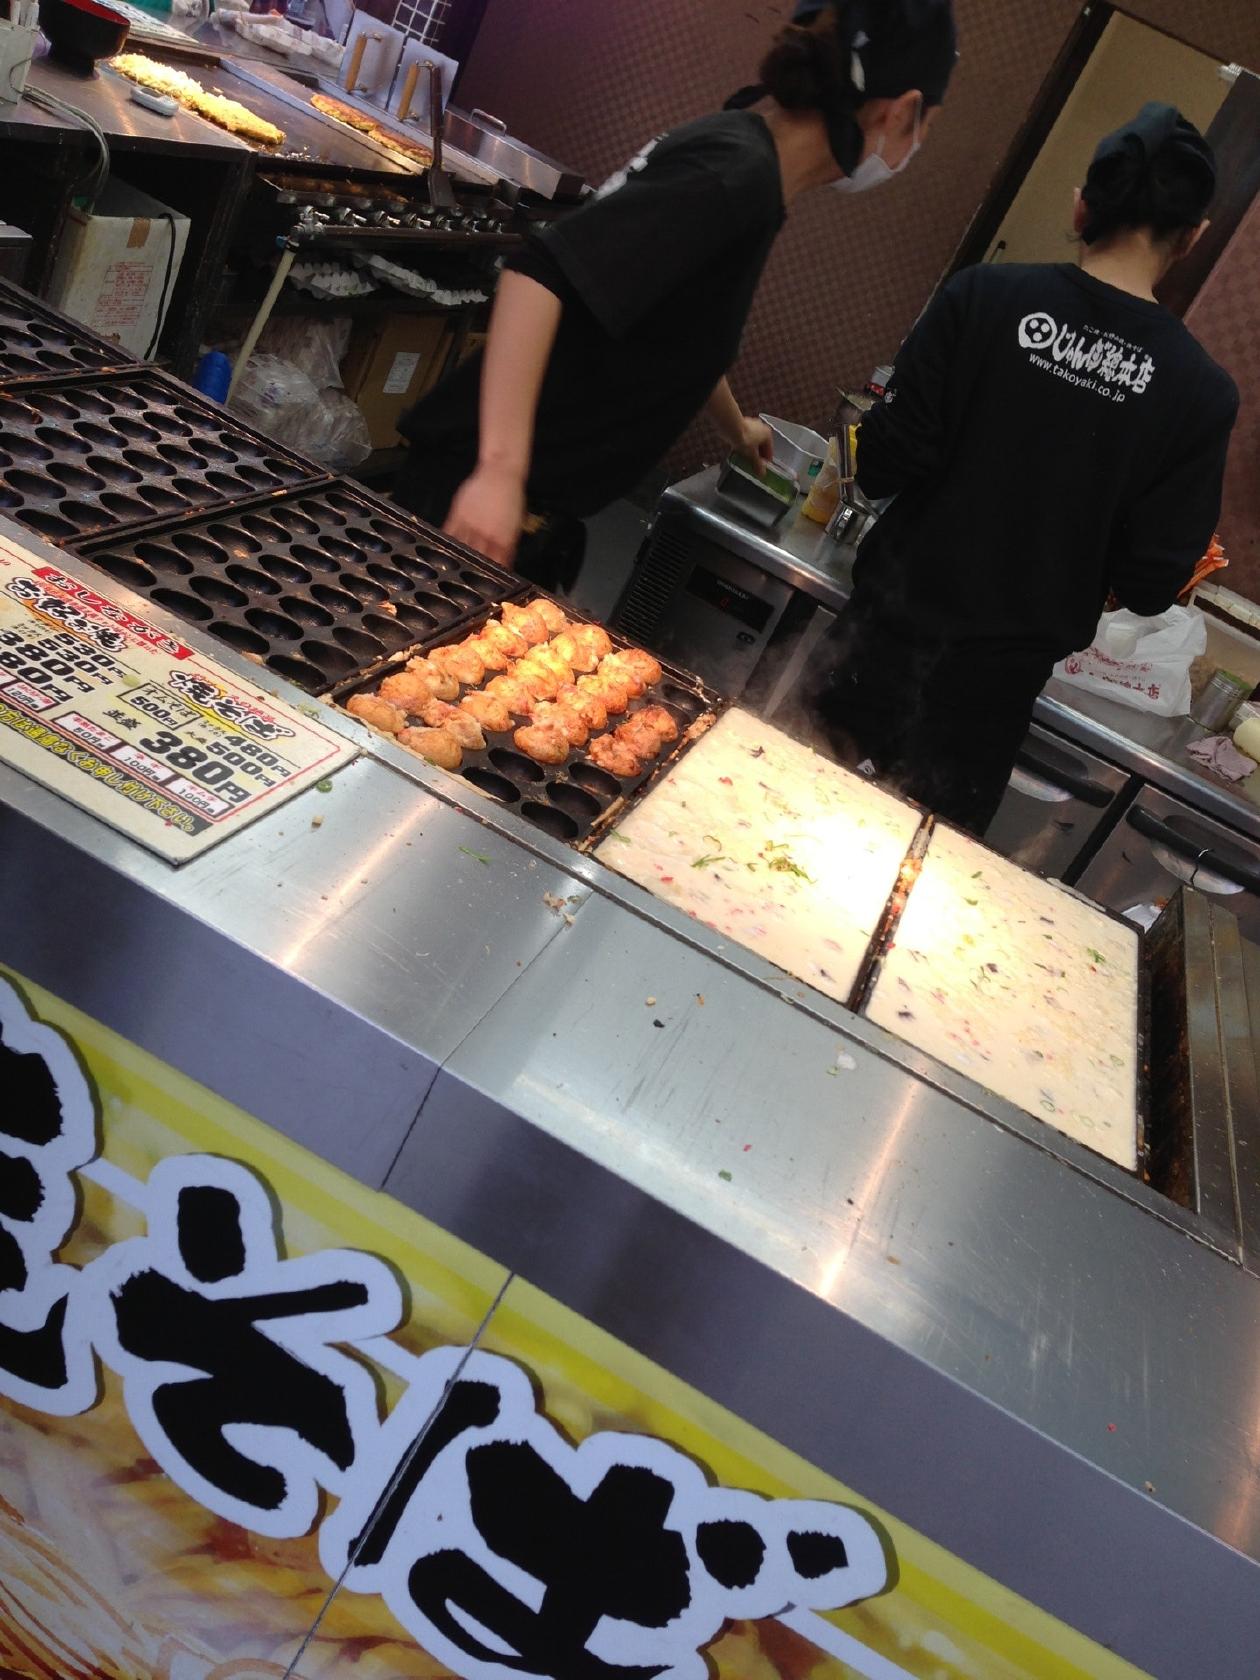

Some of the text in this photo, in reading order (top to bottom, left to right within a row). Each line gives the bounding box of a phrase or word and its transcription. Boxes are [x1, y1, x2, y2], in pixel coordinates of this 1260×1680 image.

[1029, 353, 1126, 403] www.takoyaki.co.jp
[6, 577, 128, 652] お好み焼
[45, 574, 179, 654] おしながき
[0, 650, 73, 701] 80円
[38, 638, 114, 685] 530円
[54, 632, 128, 678] 530円
[131, 695, 178, 726] 500円
[168, 670, 296, 741] 焼そば
[139, 731, 252, 803] 380円
[206, 742, 276, 787] 500円
[224, 735, 292, 778] 480円
